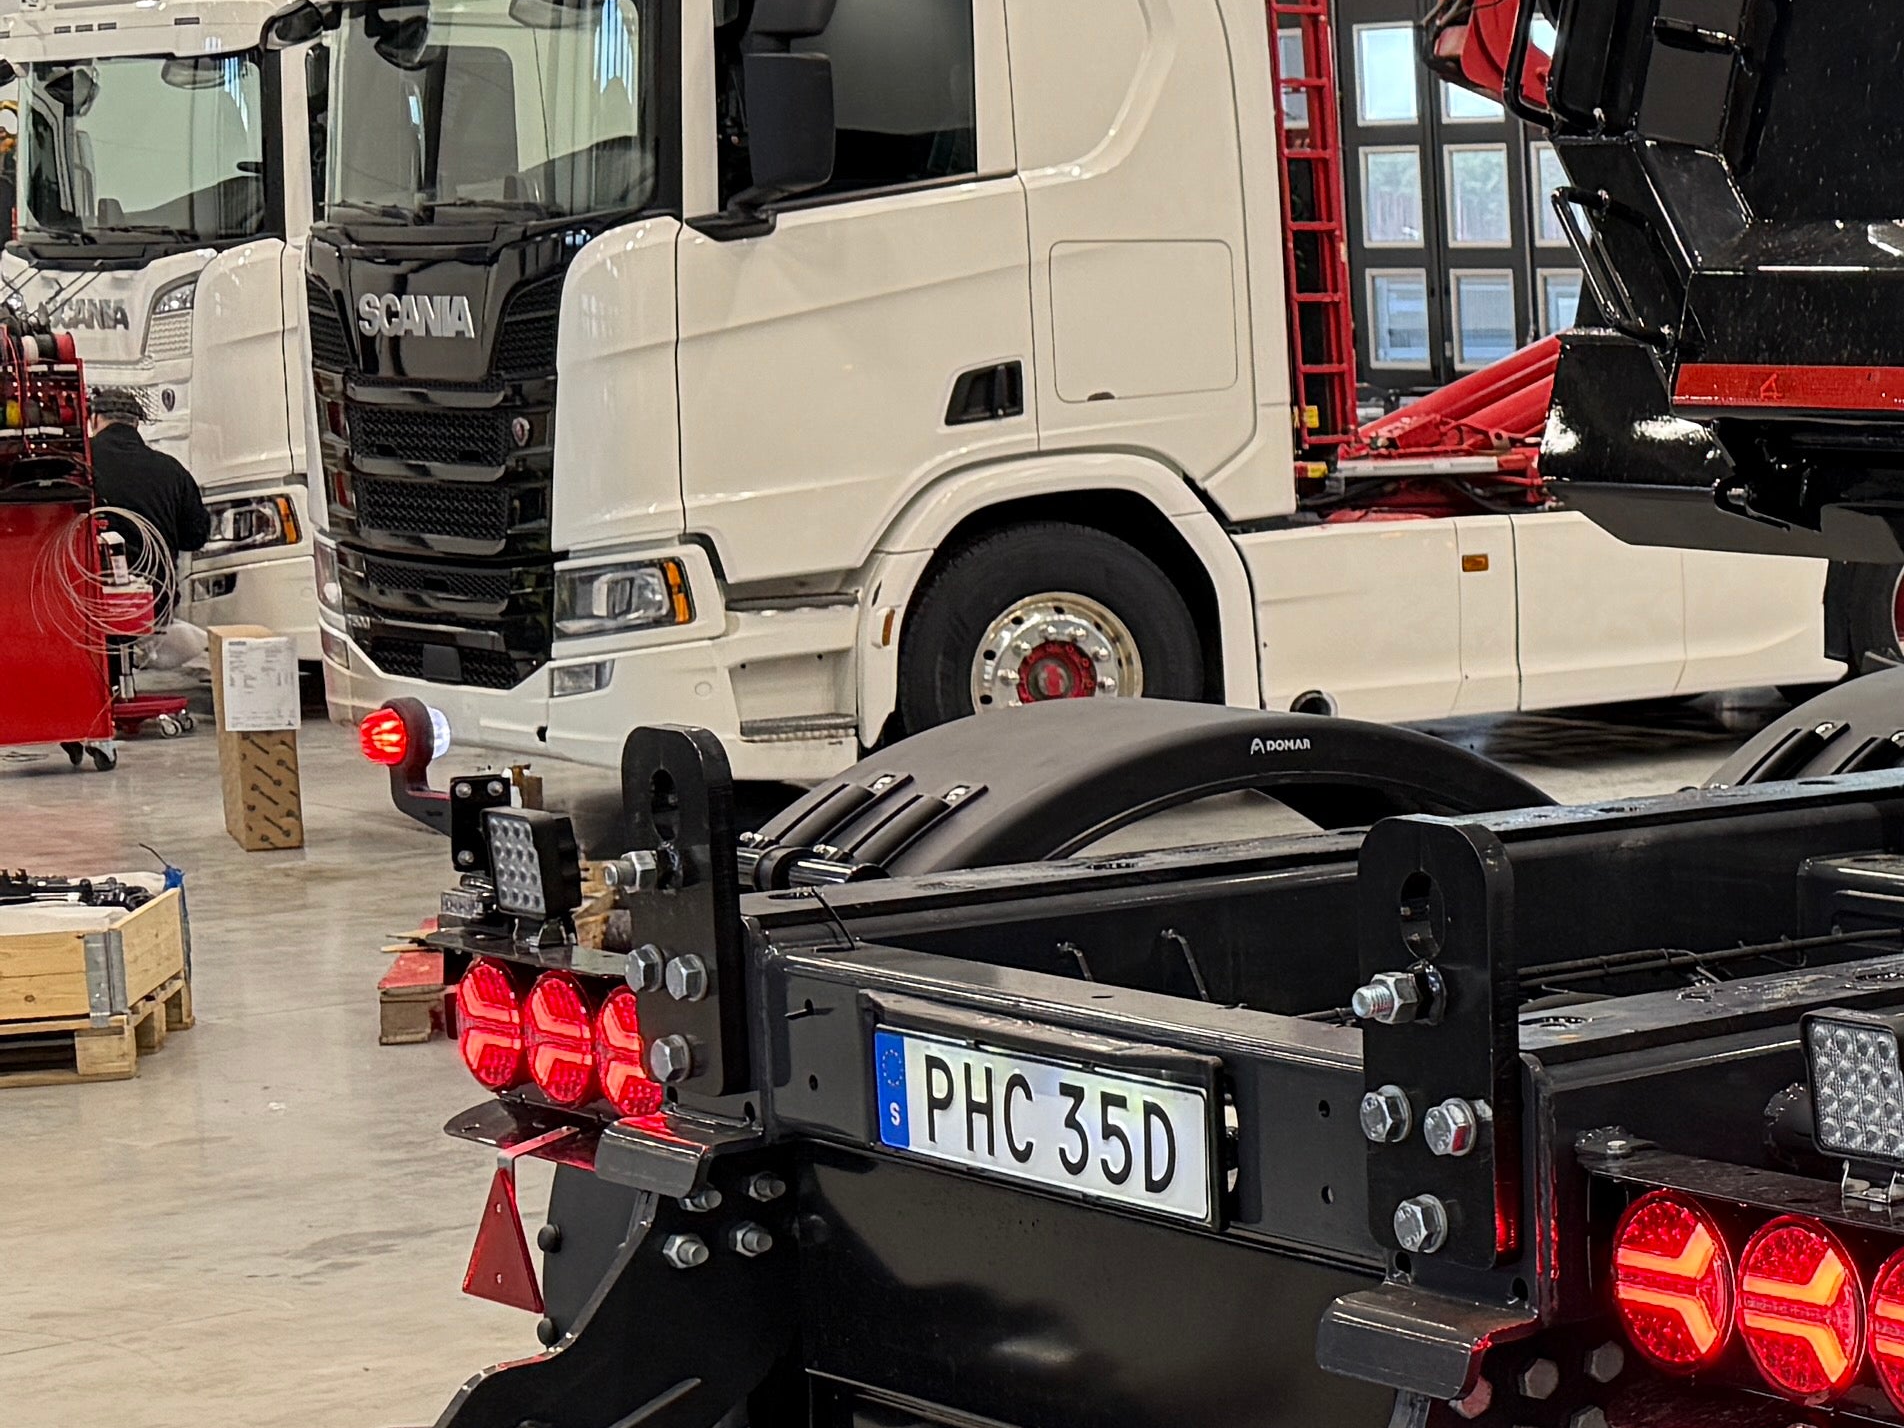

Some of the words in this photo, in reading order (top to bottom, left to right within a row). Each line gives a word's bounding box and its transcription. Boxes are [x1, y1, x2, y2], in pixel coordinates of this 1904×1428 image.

[358, 293, 475, 339] SCANIA
[889, 1102, 902, 1126] S
[924, 1053, 1034, 1164] PHC
[1058, 1081, 1177, 1194] 35D
